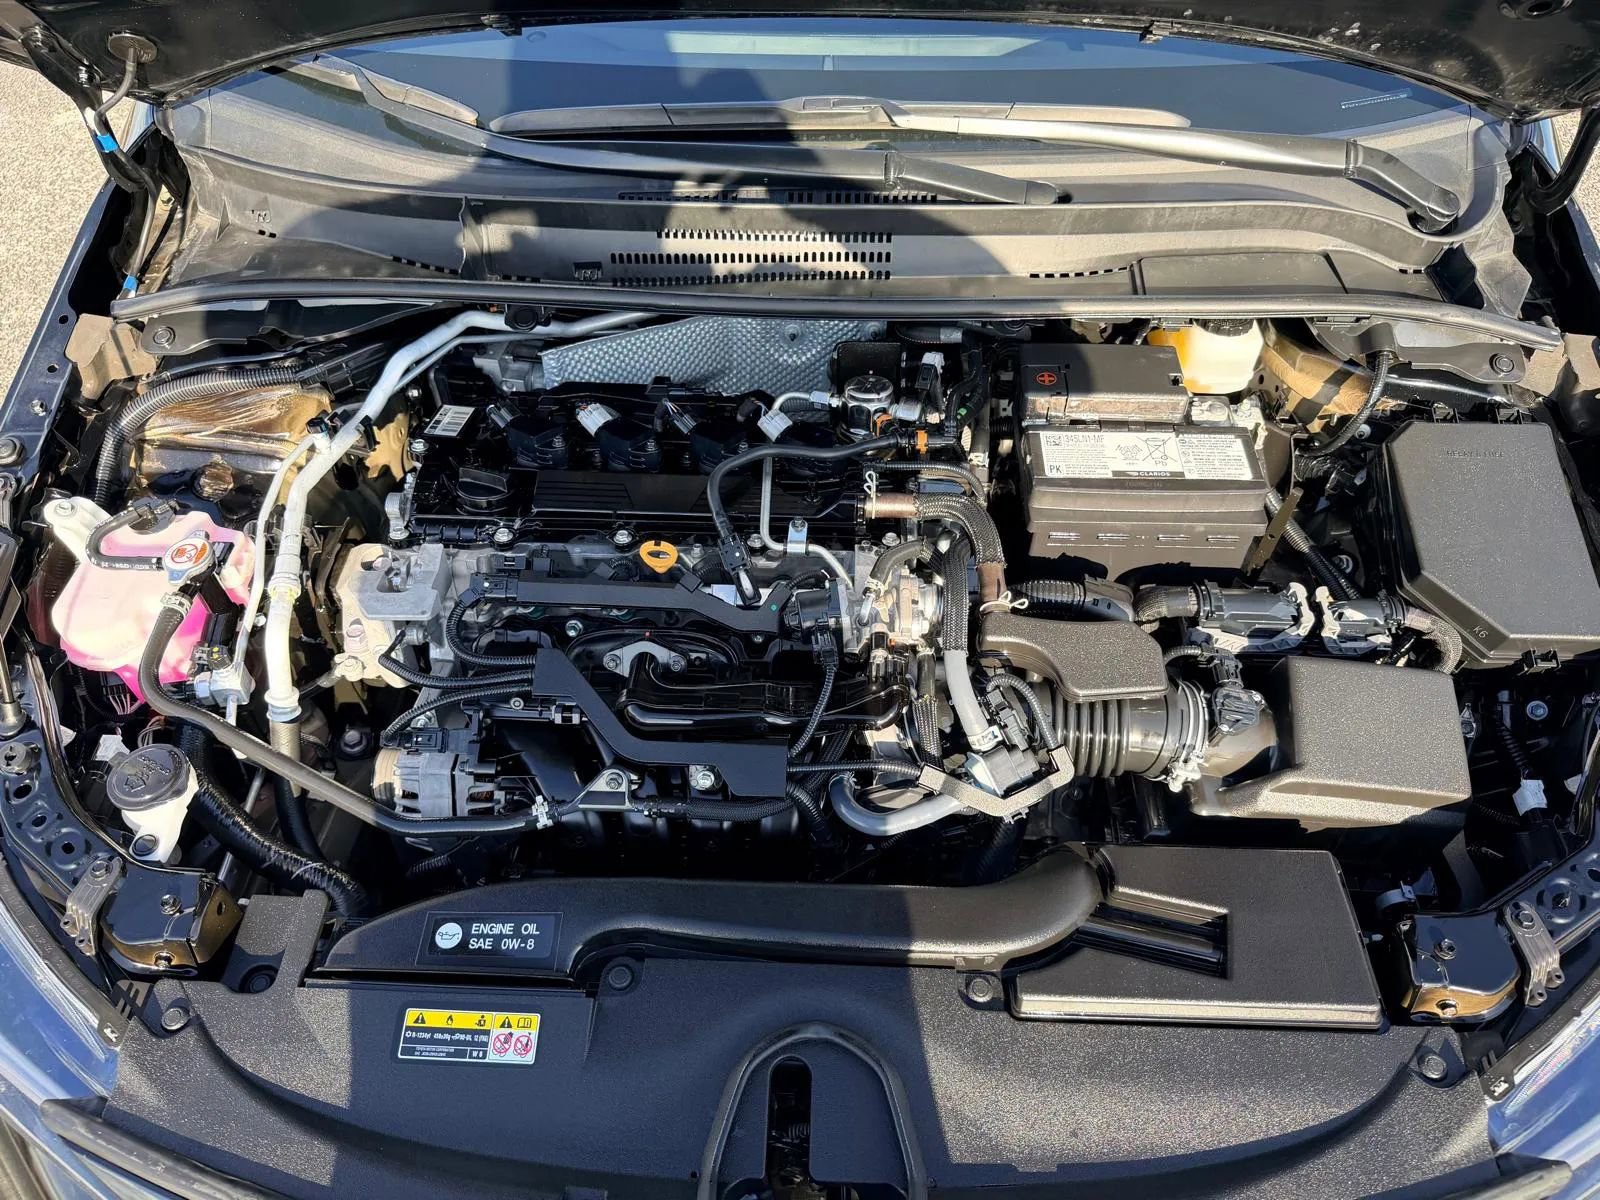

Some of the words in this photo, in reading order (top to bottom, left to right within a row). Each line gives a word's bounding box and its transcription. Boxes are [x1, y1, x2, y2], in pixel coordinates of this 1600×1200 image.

[1049, 464, 1062, 474] PK
[471, 923, 515, 935] ENGINE
[521, 923, 540, 935] OIL
[468, 938, 494, 950] SAE
[501, 938, 535, 950] 0W-8
